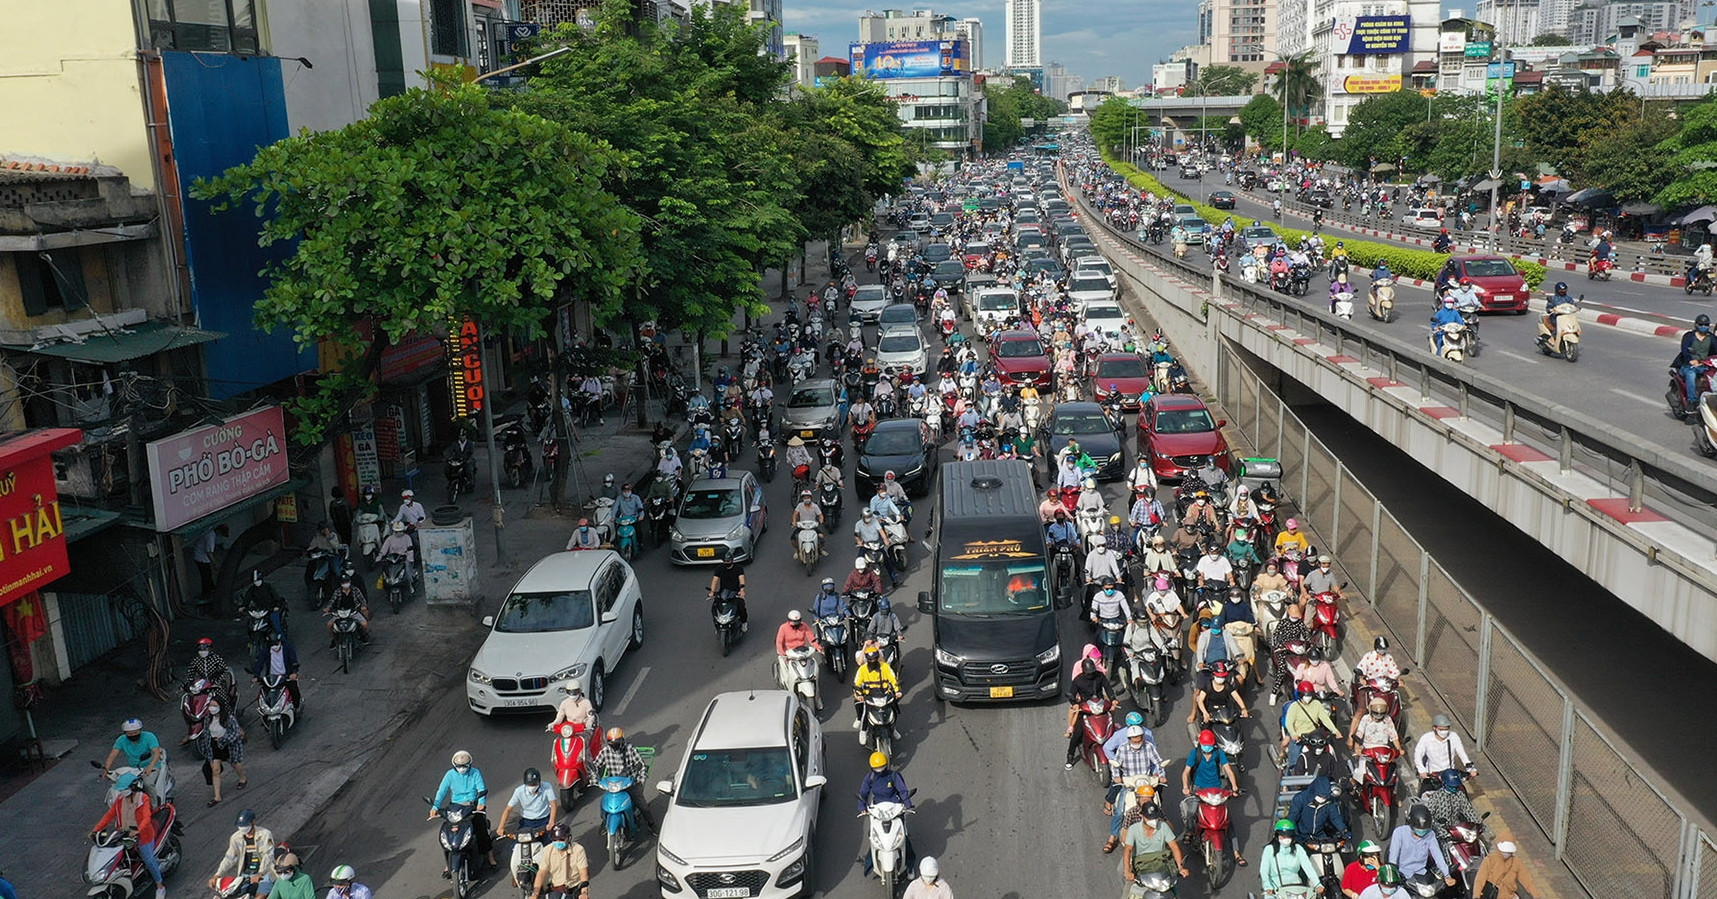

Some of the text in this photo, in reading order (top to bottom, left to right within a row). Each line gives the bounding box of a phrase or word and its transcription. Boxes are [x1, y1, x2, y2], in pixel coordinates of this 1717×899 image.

[168, 430, 280, 494] PHỞ BÒ-GÀ
[206, 480, 230, 499] RANG
[10, 494, 64, 555] HẢI
